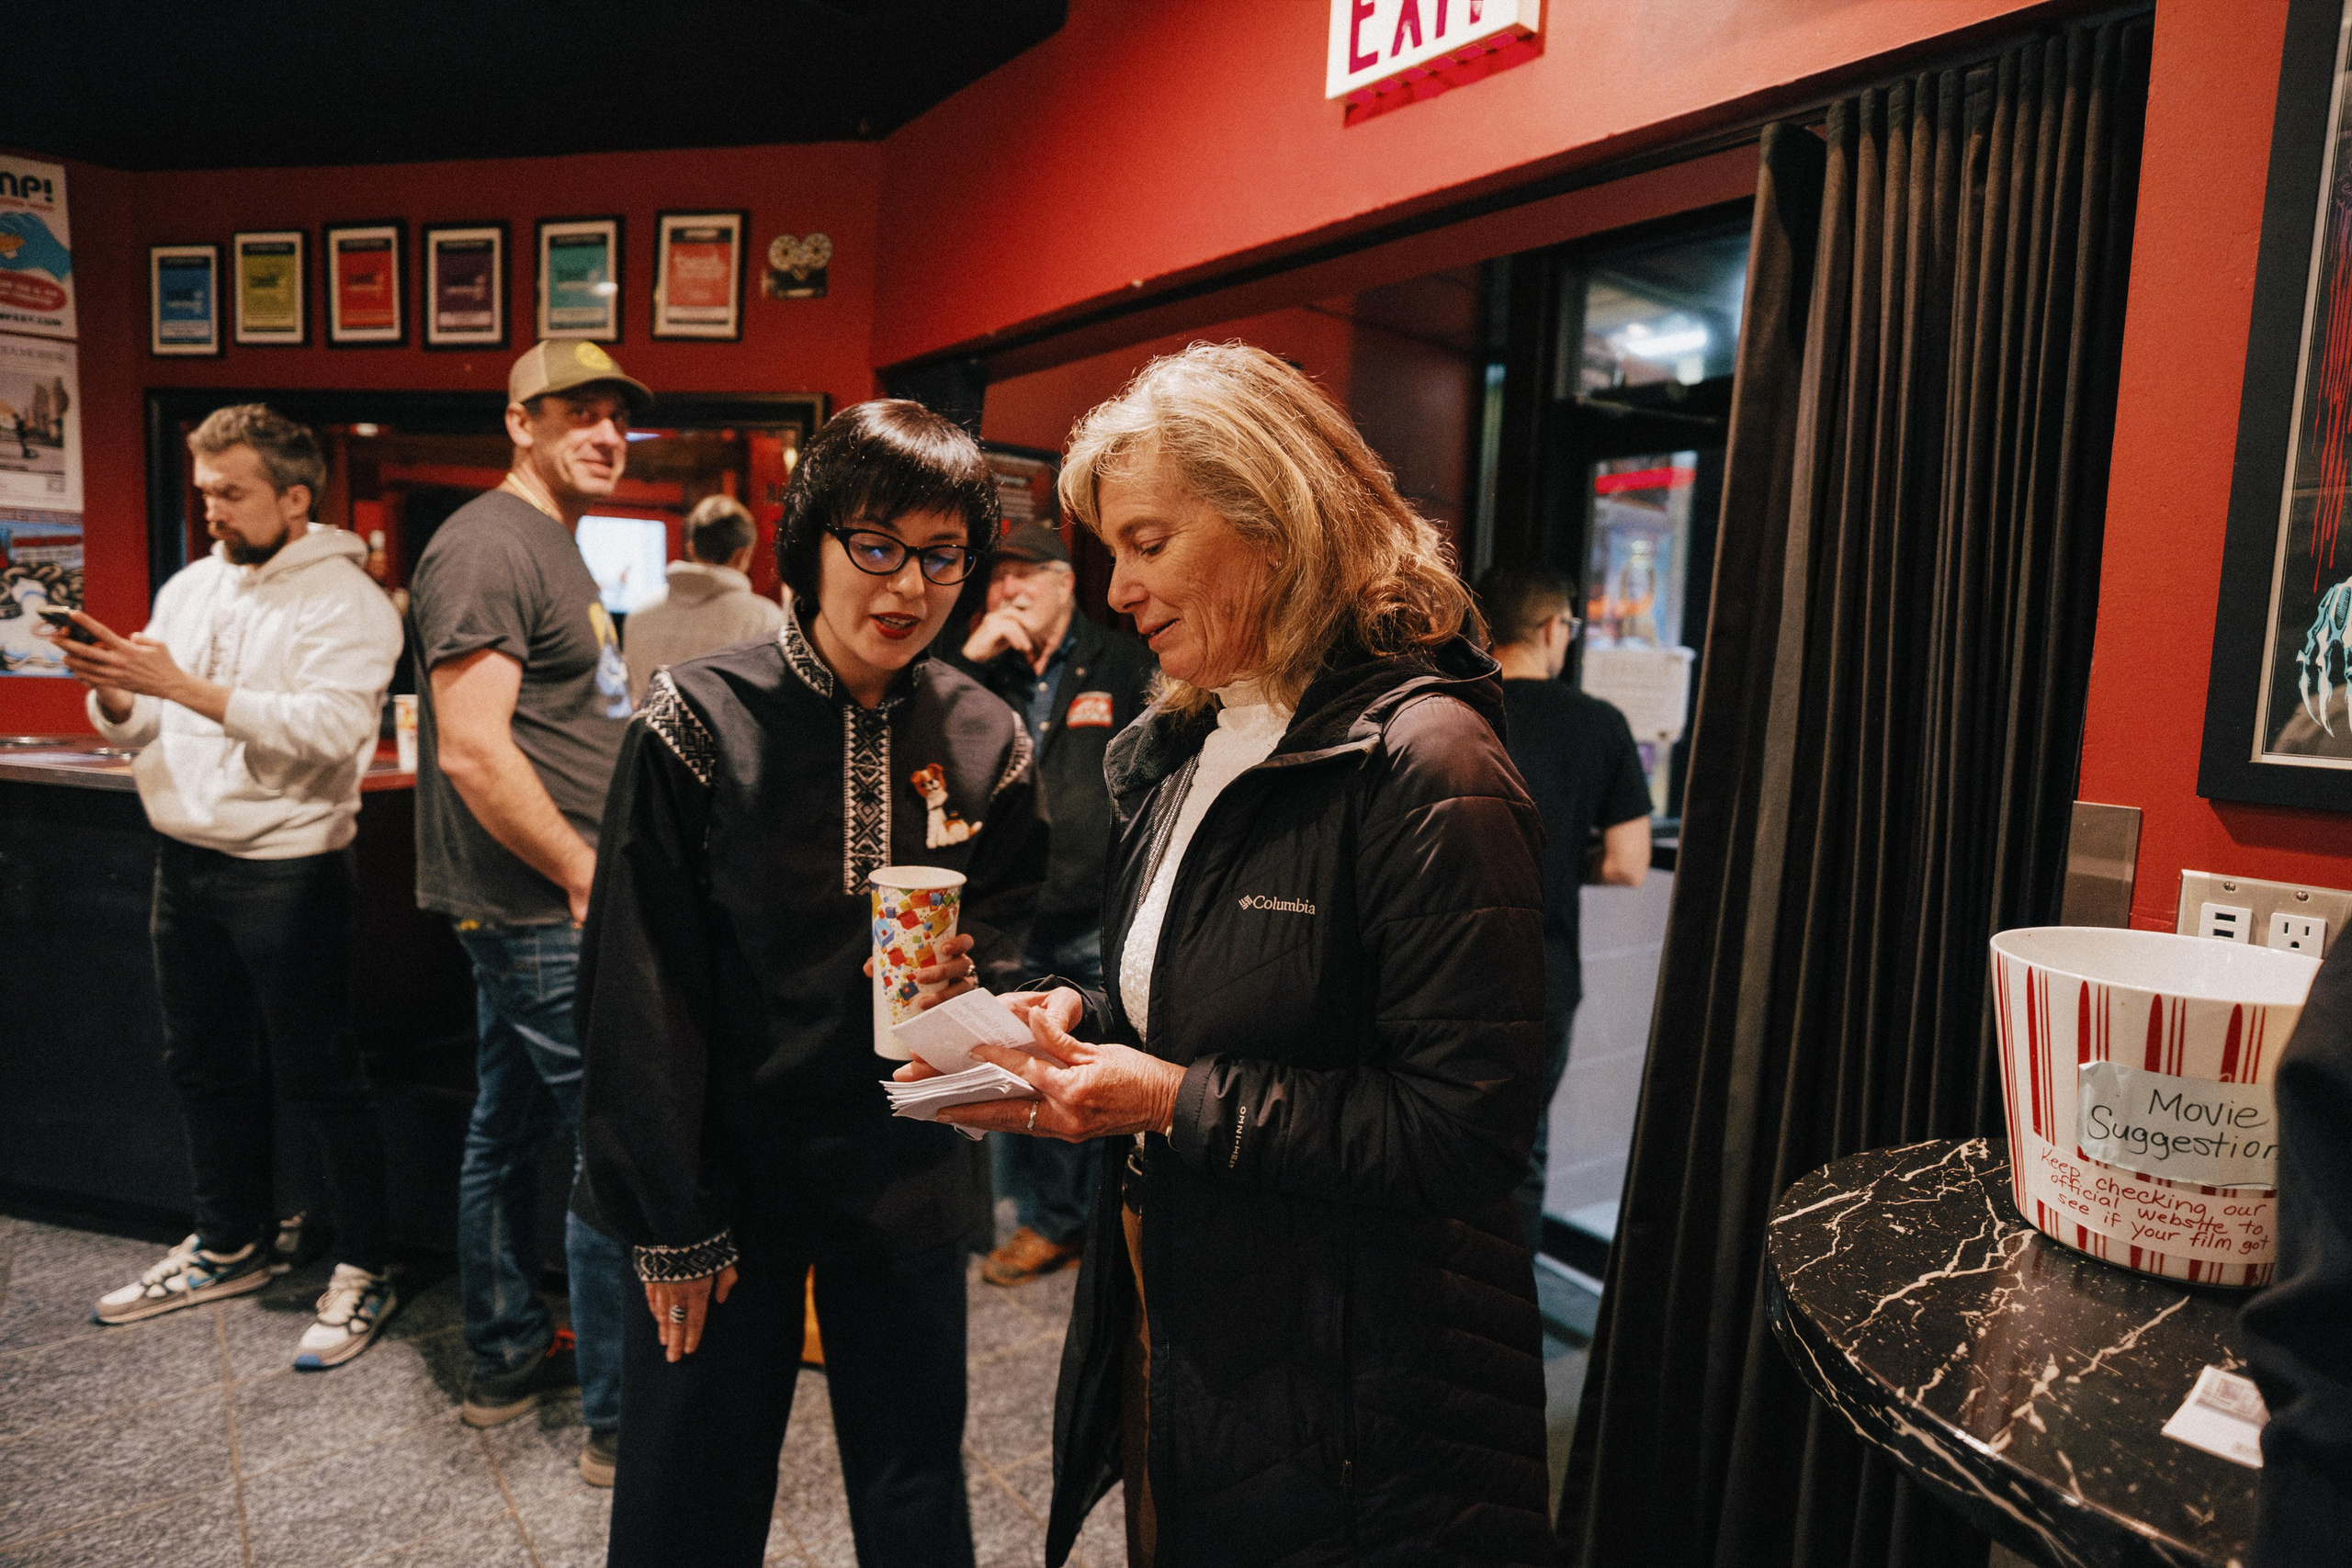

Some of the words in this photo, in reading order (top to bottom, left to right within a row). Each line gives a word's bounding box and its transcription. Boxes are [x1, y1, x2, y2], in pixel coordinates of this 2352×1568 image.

[1252, 895, 1316, 915] Columbia
[2147, 1089, 2269, 1129] Movie
[2041, 1146, 2082, 1183] Keep
[2095, 1177, 2207, 1223] checking
[2223, 1203, 2267, 1217] our
[2050, 1174, 2120, 1210] official
[2238, 1220, 2264, 1236] to
[2058, 1192, 2090, 1215] see
[2104, 1212, 2122, 1228] if
[2189, 1231, 2233, 1251] film
[2238, 1235, 2271, 1255] got
